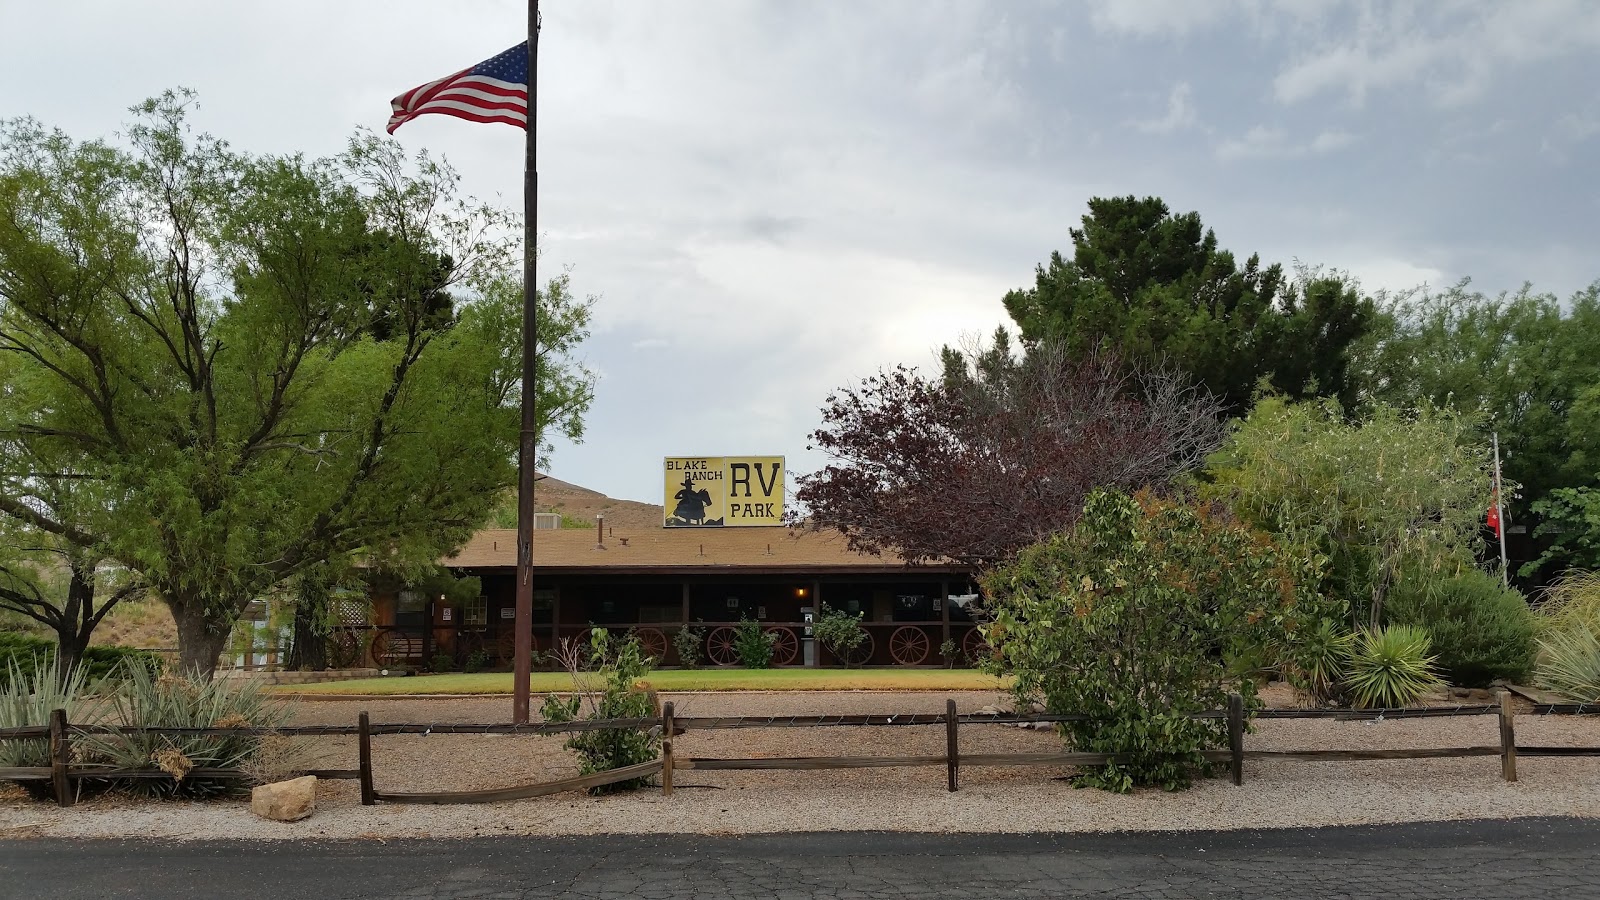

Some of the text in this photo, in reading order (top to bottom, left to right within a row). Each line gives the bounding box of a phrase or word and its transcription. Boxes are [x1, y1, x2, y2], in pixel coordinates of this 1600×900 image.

[666, 460, 707, 470] BLAKE
[684, 471, 723, 480] RANCH
[730, 463, 780, 497] RV
[731, 503, 775, 517] PARK
